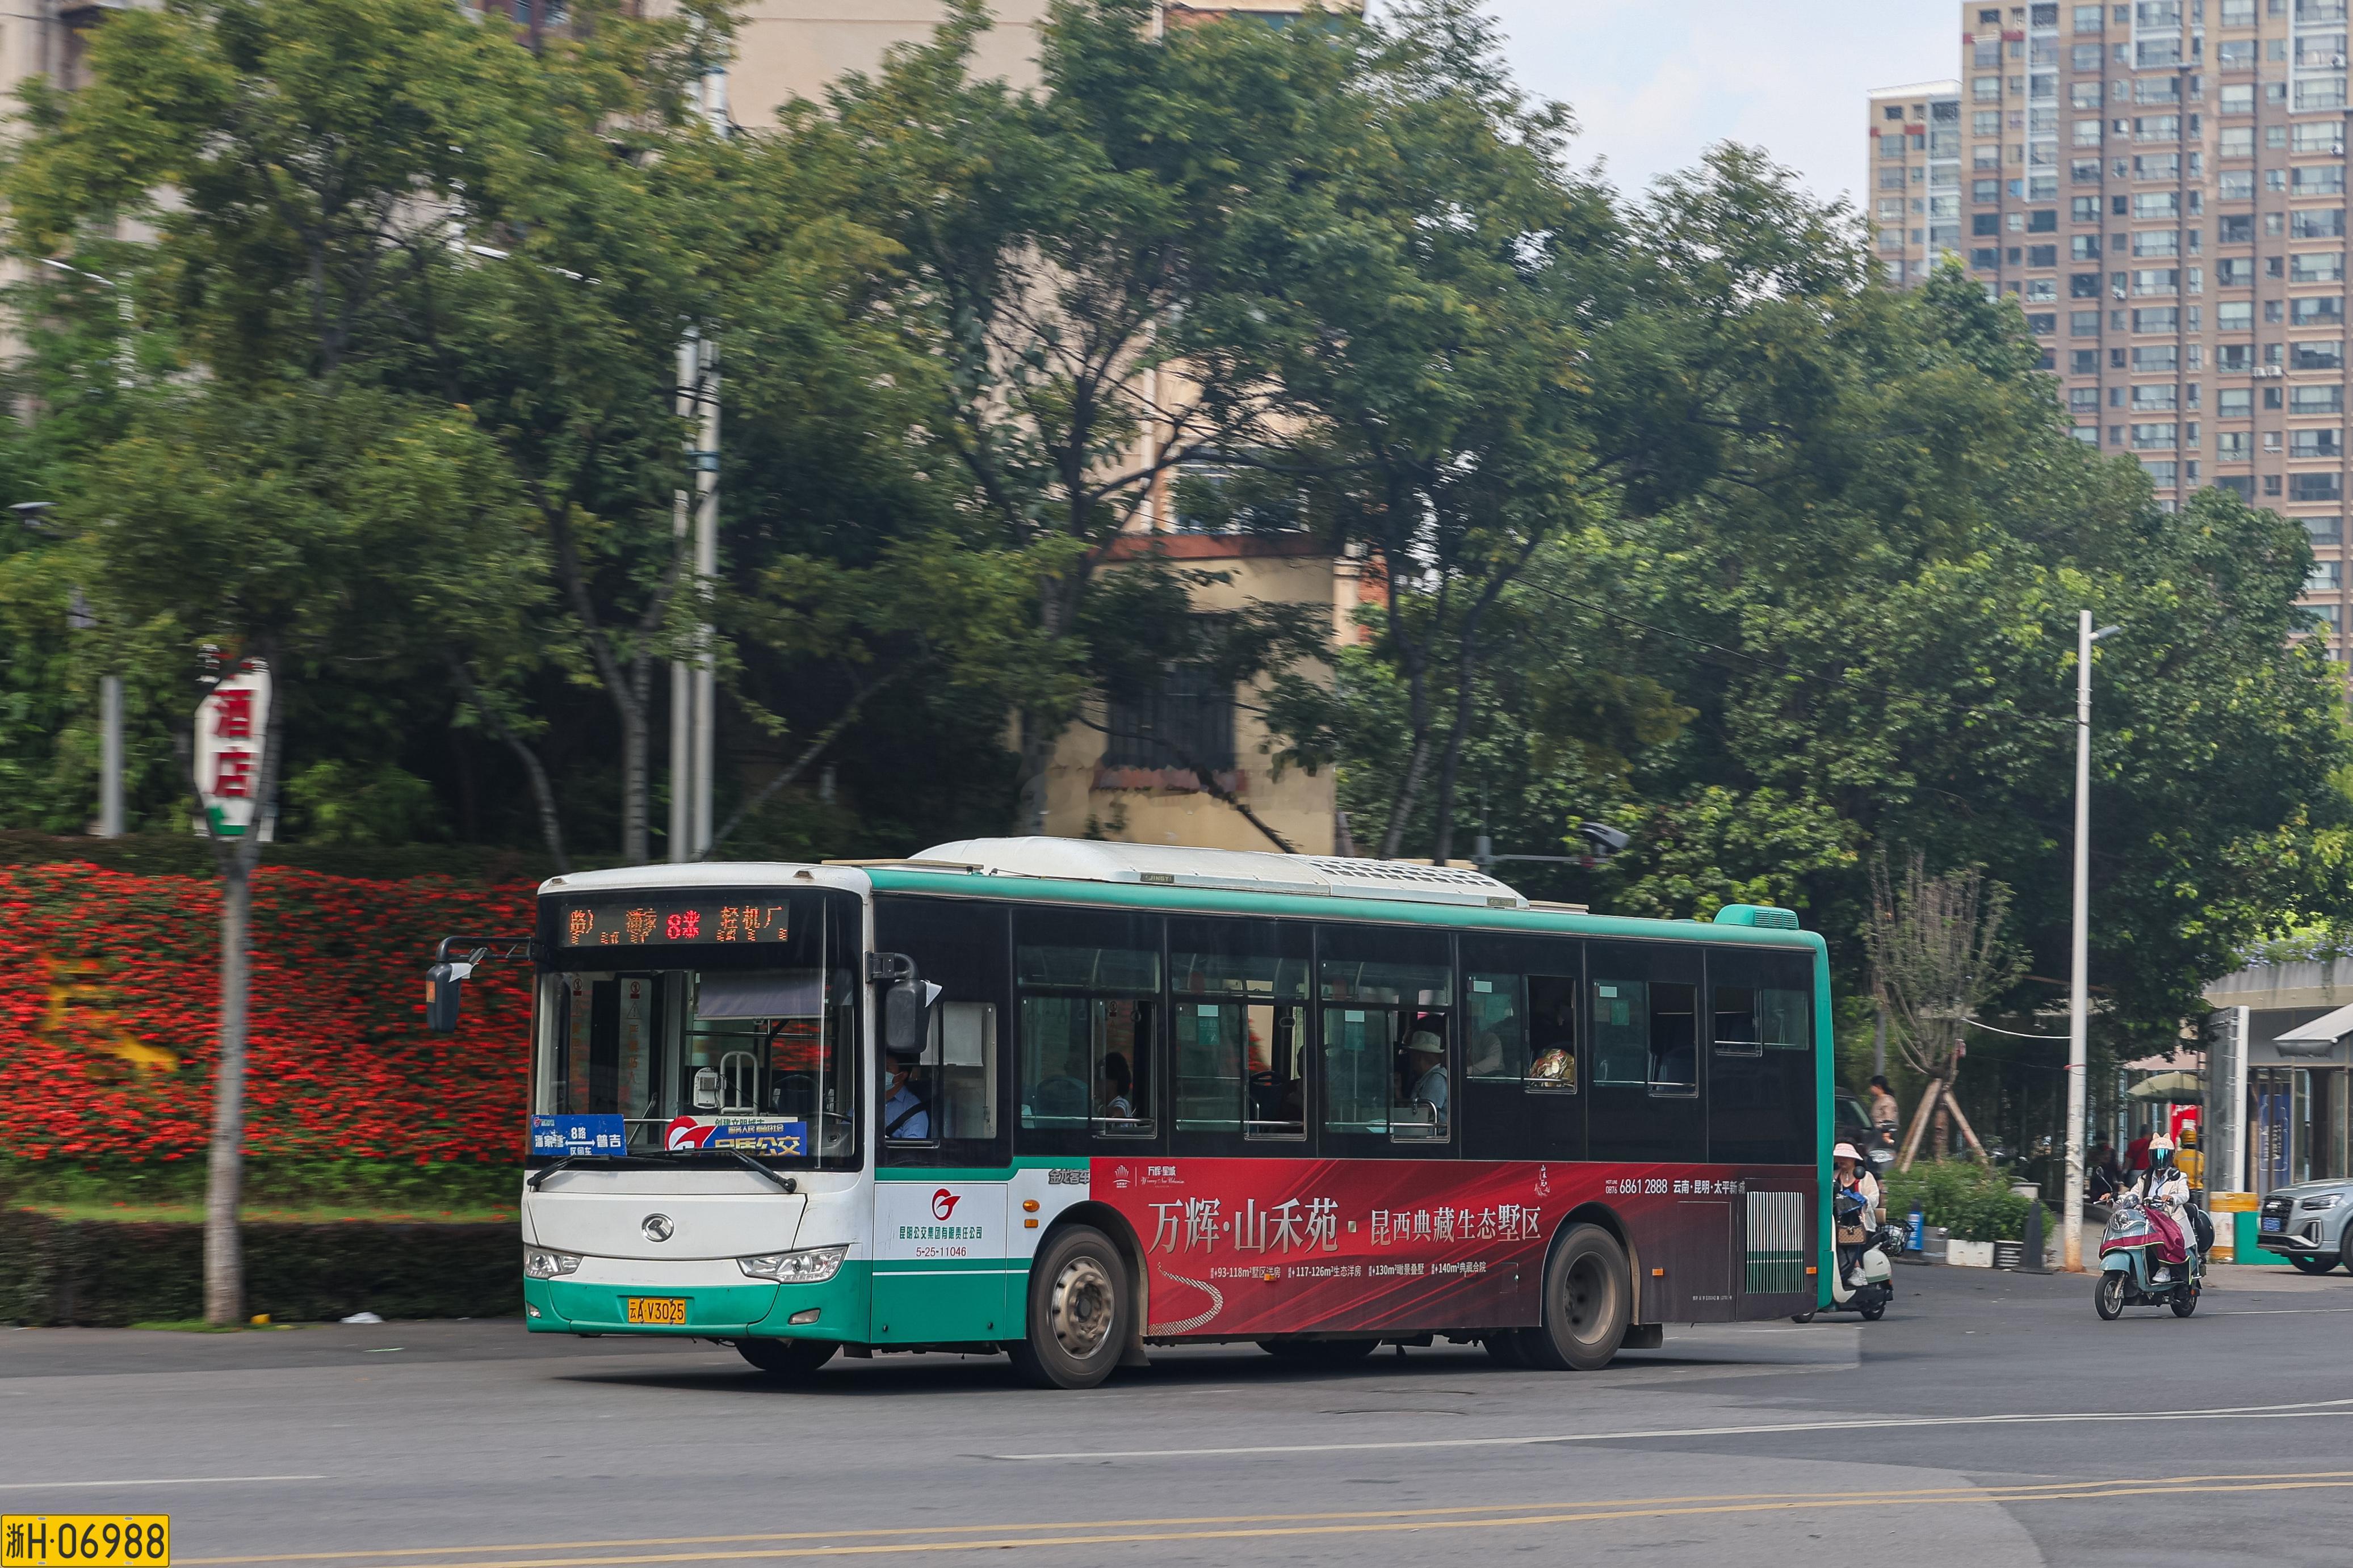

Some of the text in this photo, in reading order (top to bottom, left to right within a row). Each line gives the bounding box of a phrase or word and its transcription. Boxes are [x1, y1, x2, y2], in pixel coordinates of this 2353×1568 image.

[571, 1126, 586, 1140] 8路
[596, 1134, 621, 1147] 普吉
[1048, 1168, 1090, 1184] 金龙客车
[1620, 1179, 1642, 1194] 6861
[1644, 1178, 1668, 1194] 2888
[899, 1226, 983, 1239] 昆明公交集团有限责任公司
[1148, 1197, 1542, 1254] 万辉·山禾苑 昆西典藏生态墅区
[916, 1246, 967, 1257] 5-25-11046
